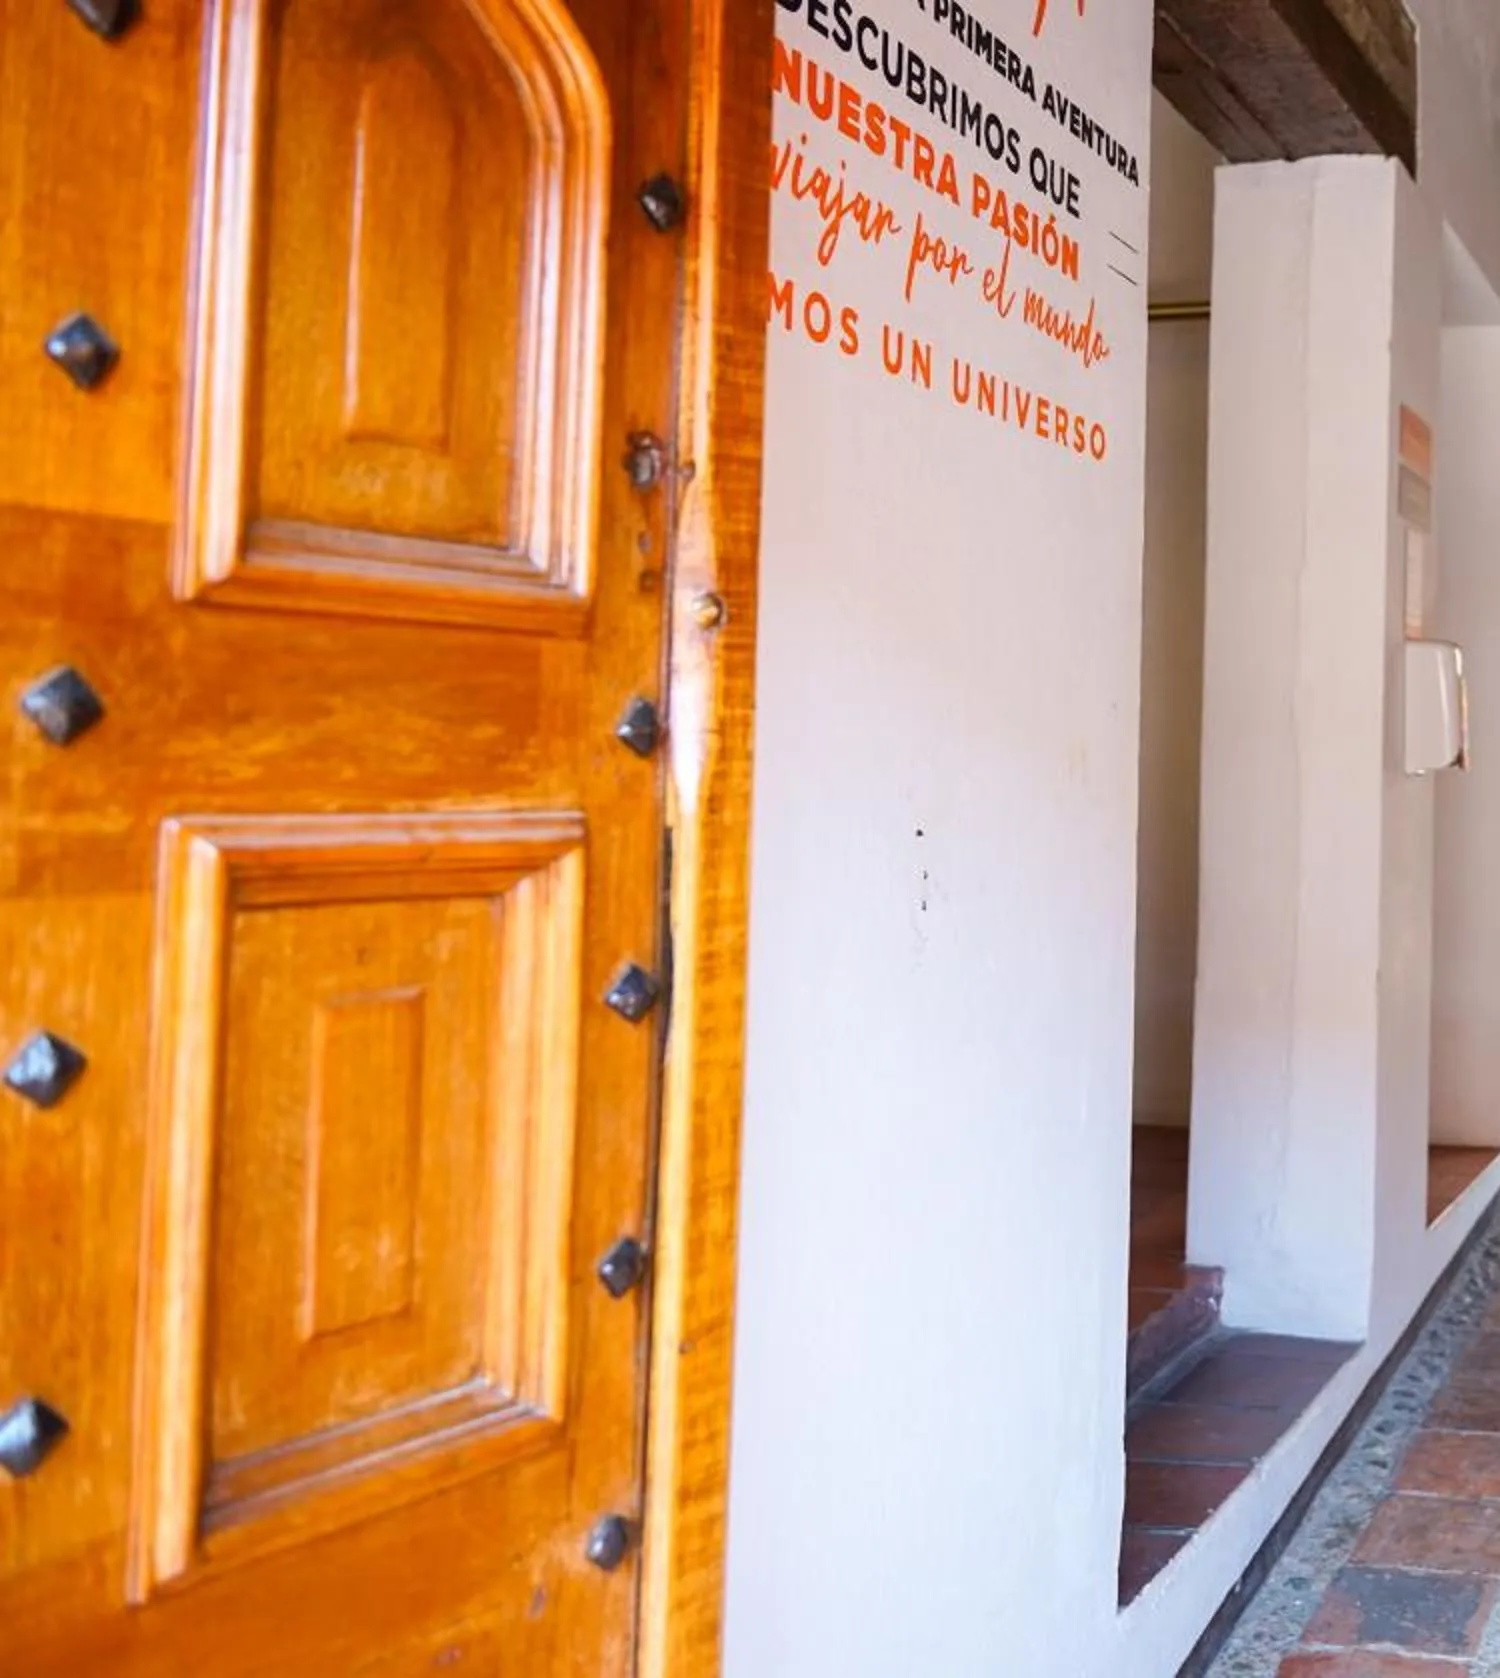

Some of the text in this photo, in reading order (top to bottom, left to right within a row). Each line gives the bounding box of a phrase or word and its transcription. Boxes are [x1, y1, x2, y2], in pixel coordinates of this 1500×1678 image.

[773, 36, 1079, 281] NUESTRA PASIÓN
[932, 0, 1140, 187] PRIMERA AVENTURA
[1029, 147, 1081, 219] QUE
[771, 133, 1110, 368] viajar por el mundo
[883, 325, 932, 389] UN
[953, 358, 1106, 461] UNIVERSO
